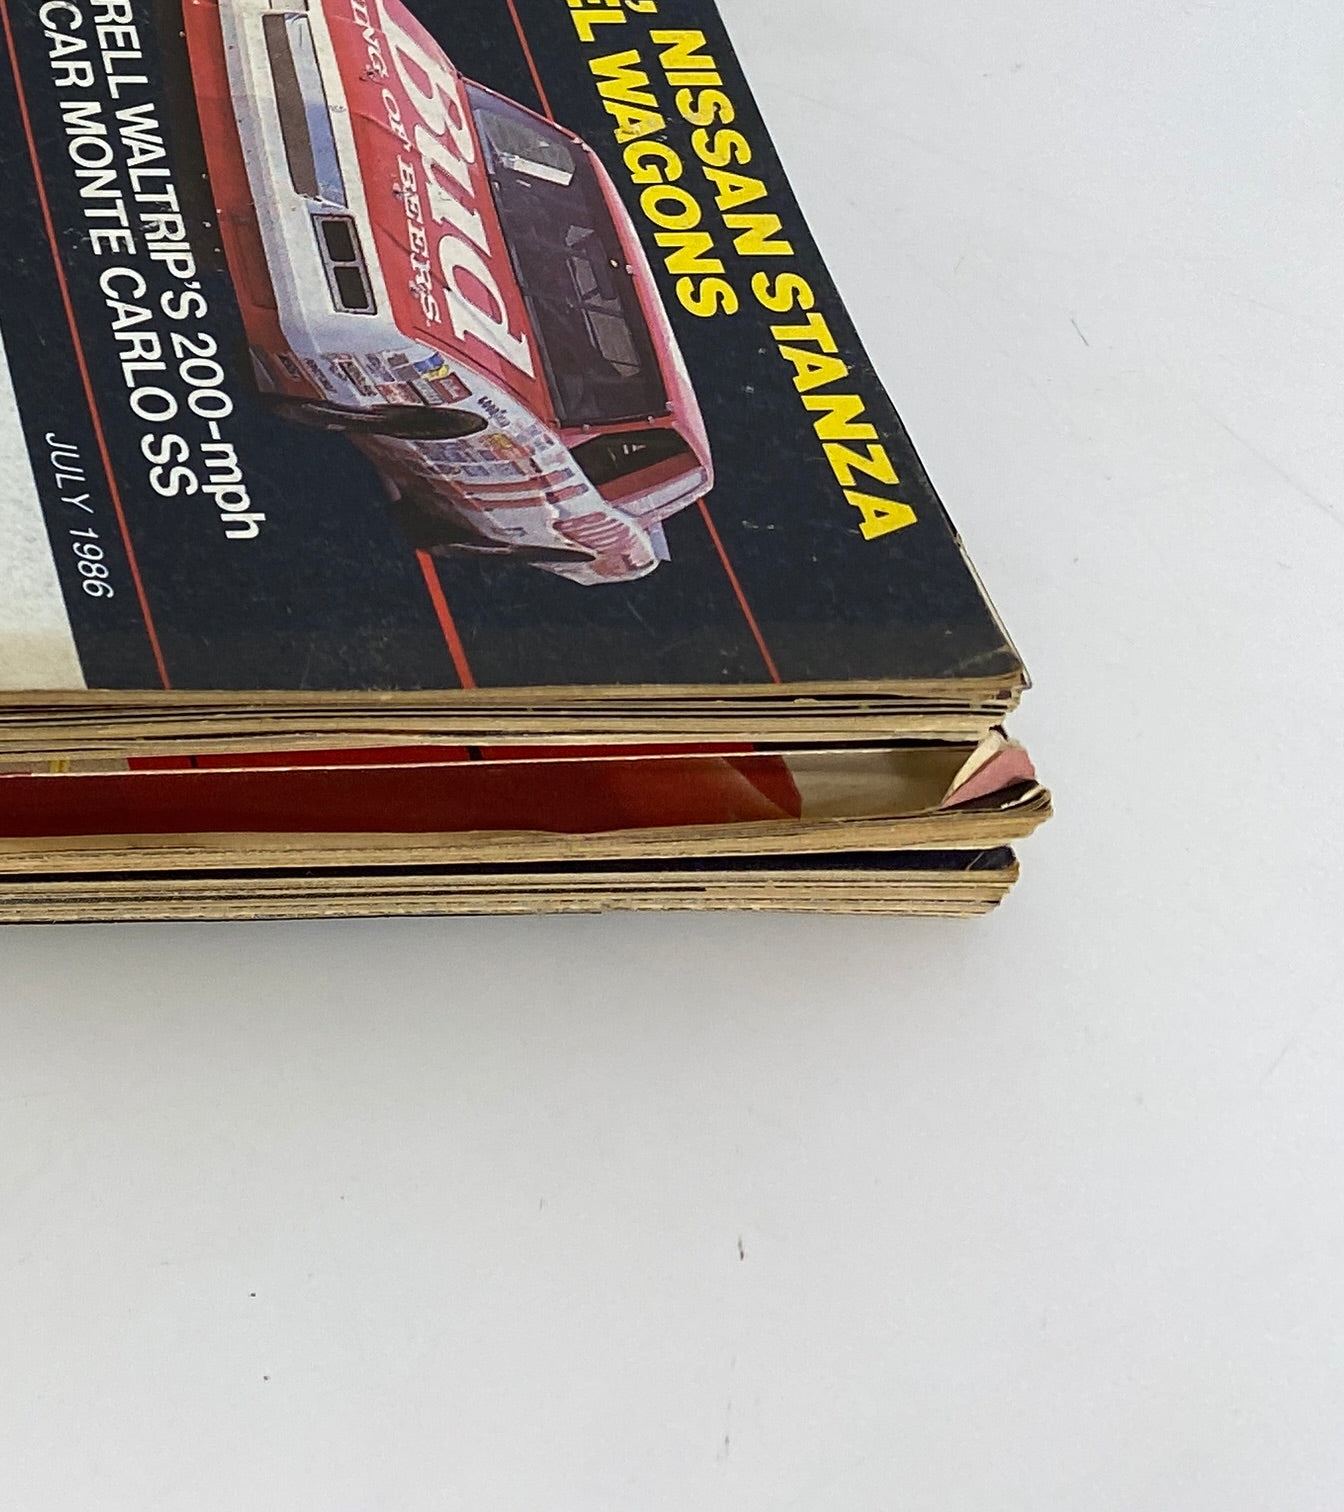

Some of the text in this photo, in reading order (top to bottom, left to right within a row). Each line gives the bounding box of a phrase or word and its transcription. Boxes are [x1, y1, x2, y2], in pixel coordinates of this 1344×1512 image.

[59, 100, 137, 257] MONTE
[383, 88, 414, 149] OF
[589, 49, 739, 318] WAGONS
[94, 267, 177, 423] CARLO
[115, 102, 208, 321] WALTRIP'S
[172, 331, 266, 541] 200-mph
[650, 29, 794, 257] NISSAN
[751, 270, 917, 542] STANZA
[47, 431, 114, 600] JULY 1986
[141, 433, 199, 499] SS
